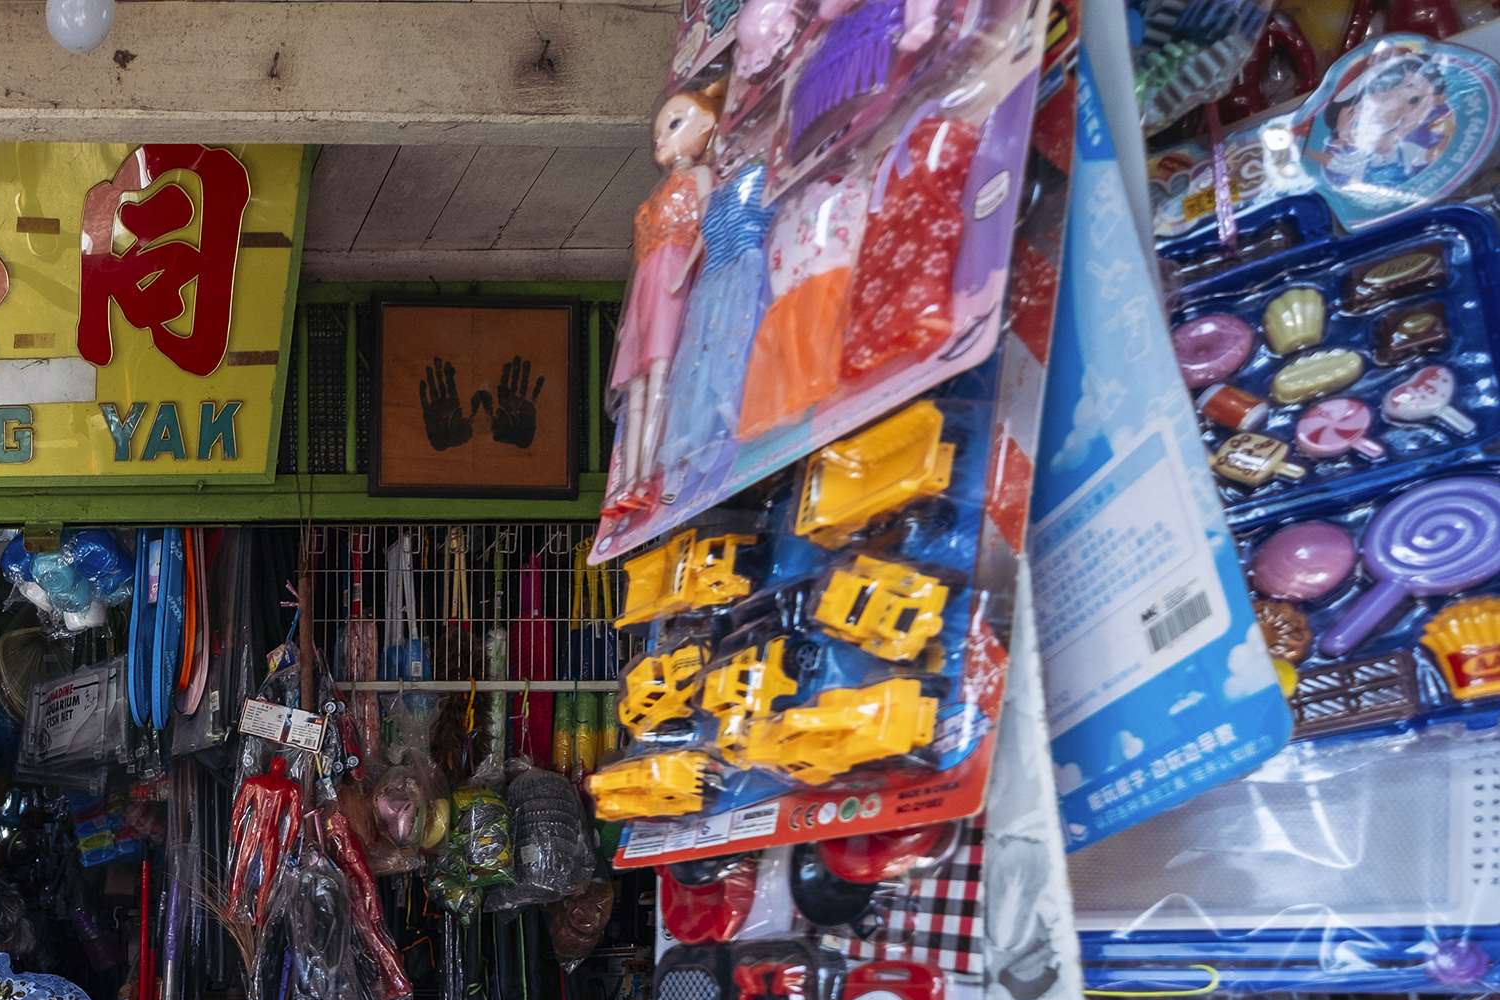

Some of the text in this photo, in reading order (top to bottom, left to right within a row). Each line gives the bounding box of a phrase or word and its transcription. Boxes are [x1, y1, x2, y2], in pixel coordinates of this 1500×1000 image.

[98, 401, 243, 463] YAK
[46, 709, 74, 729] FISH NET
